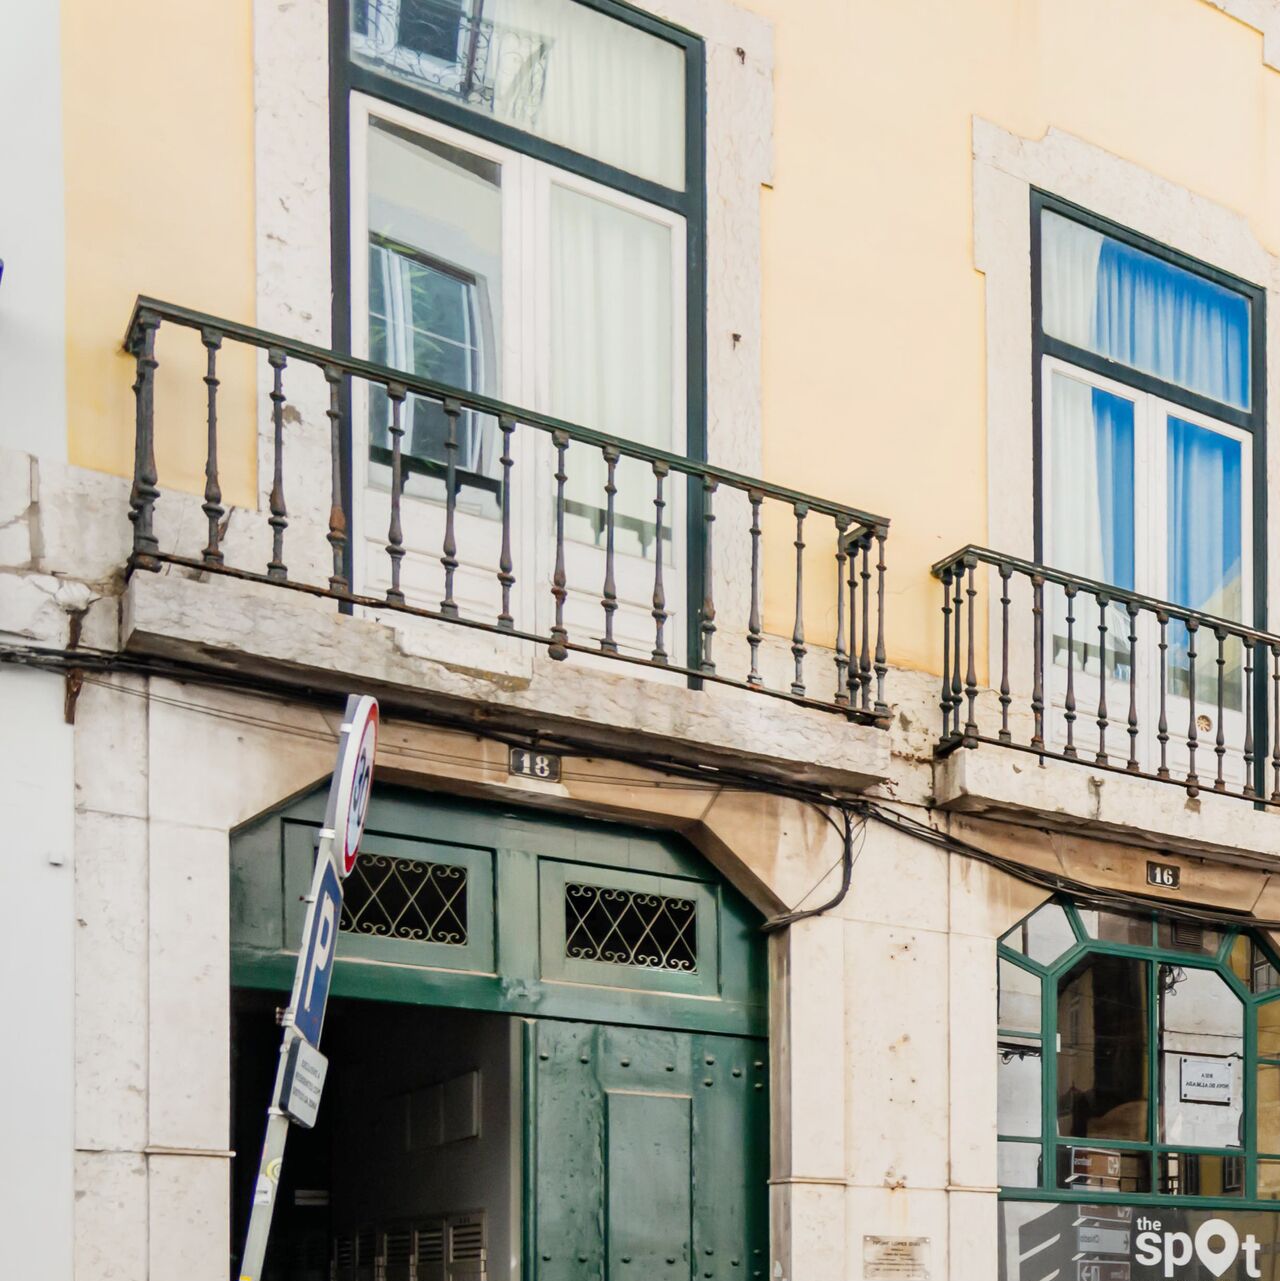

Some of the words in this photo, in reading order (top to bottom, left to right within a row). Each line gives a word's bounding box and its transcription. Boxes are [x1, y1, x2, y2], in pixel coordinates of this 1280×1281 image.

[521, 752, 550, 777] 18
[353, 747, 370, 826] 30
[1155, 867, 1173, 885] 16
[304, 890, 335, 1010] P
[1136, 1216, 1162, 1231] the
